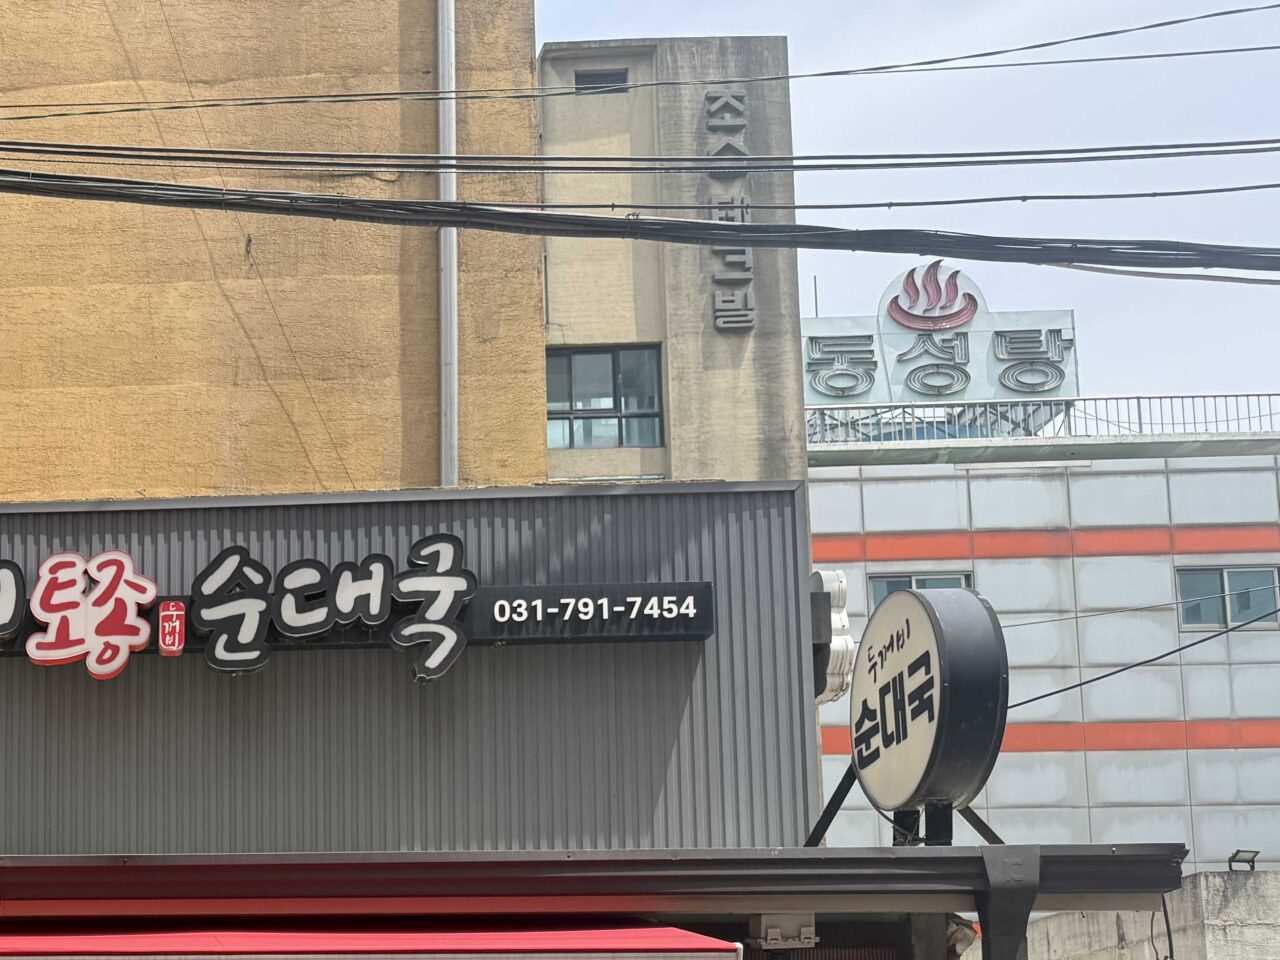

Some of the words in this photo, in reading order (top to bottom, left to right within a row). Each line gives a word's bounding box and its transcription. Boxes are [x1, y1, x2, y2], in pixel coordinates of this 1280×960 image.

[806, 329, 1074, 397] 동성탕
[32, 556, 150, 667] 토종
[197, 541, 470, 670] 순대국
[492, 595, 699, 624] 031-791-7454
[867, 617, 912, 684] 두꺼비
[854, 649, 935, 771] 순대국
